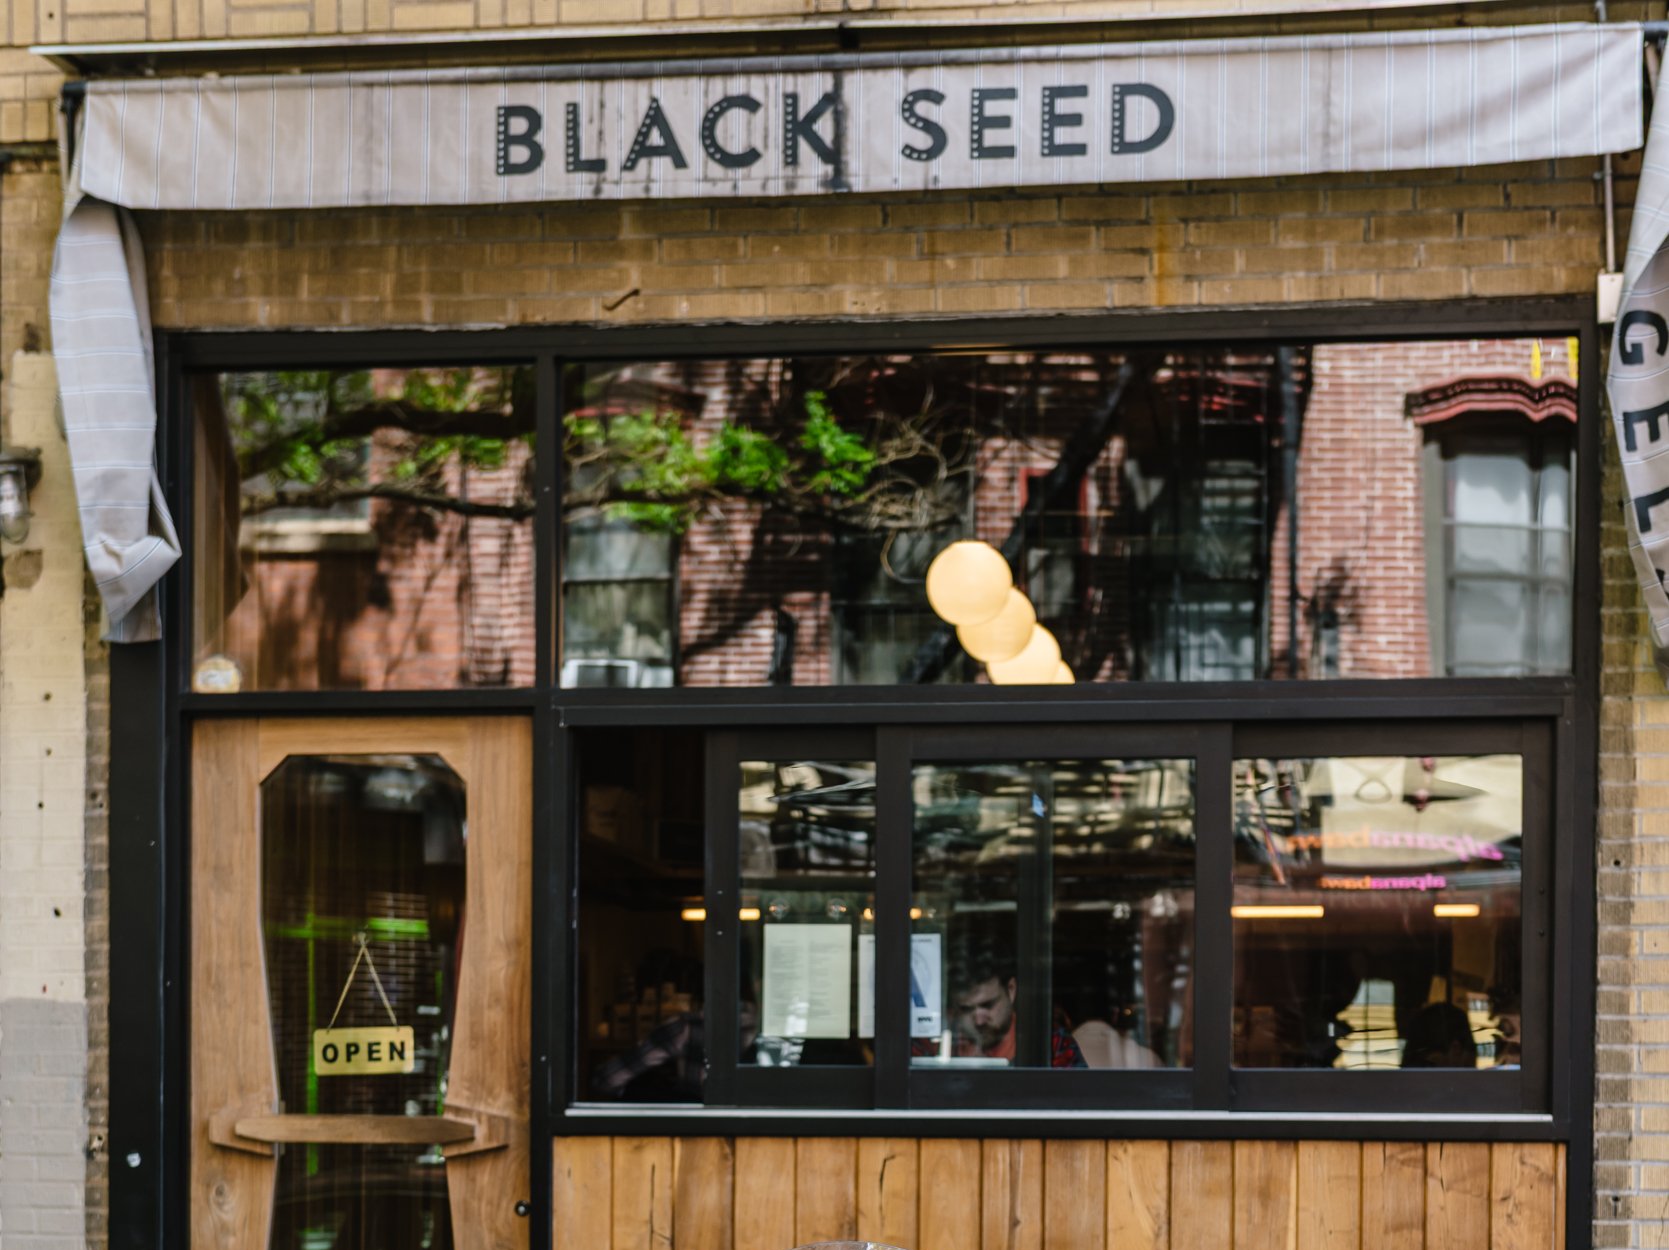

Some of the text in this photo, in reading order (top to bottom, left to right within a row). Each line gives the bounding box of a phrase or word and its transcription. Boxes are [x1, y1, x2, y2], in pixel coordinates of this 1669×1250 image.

[496, 82, 1176, 175] BLACK SEED
[322, 1041, 405, 1063] OPEN
